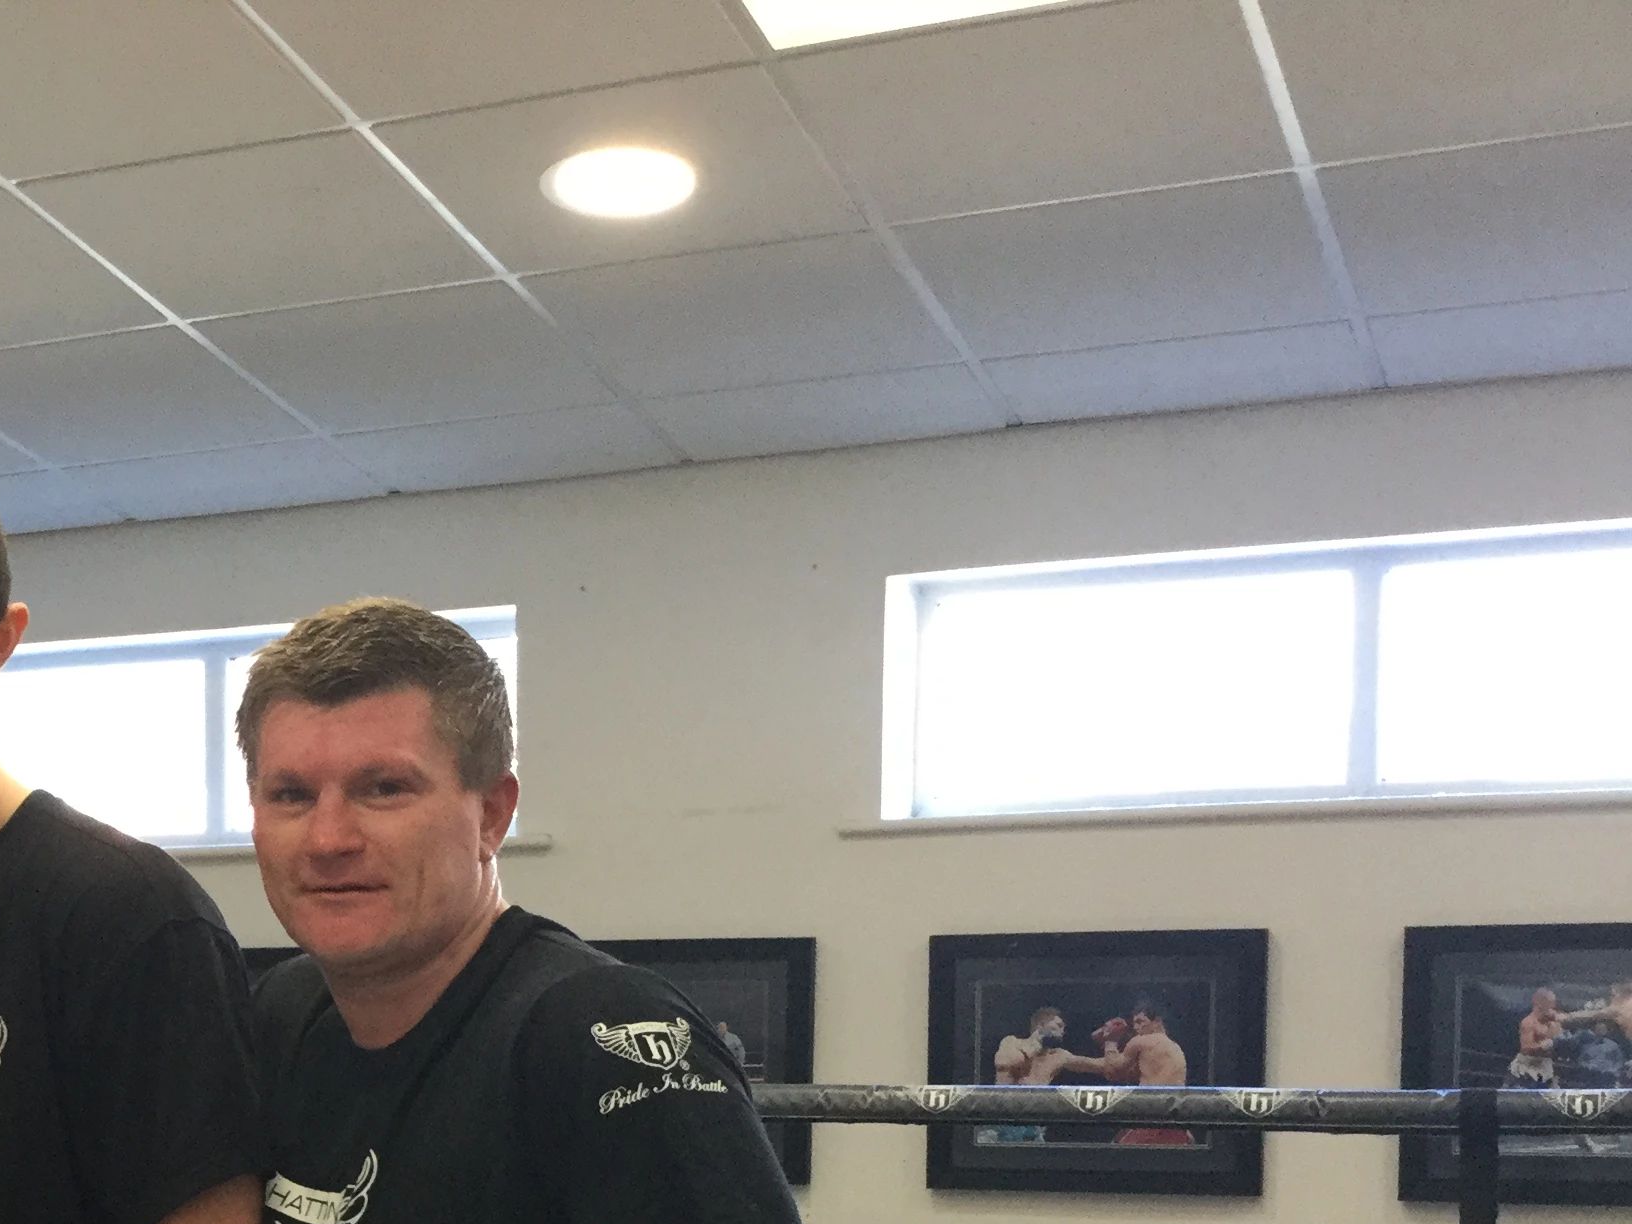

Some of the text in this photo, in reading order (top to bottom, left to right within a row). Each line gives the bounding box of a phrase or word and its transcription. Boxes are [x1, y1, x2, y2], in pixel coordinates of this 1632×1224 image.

[598, 1072, 729, 1115] Pride In Battle
